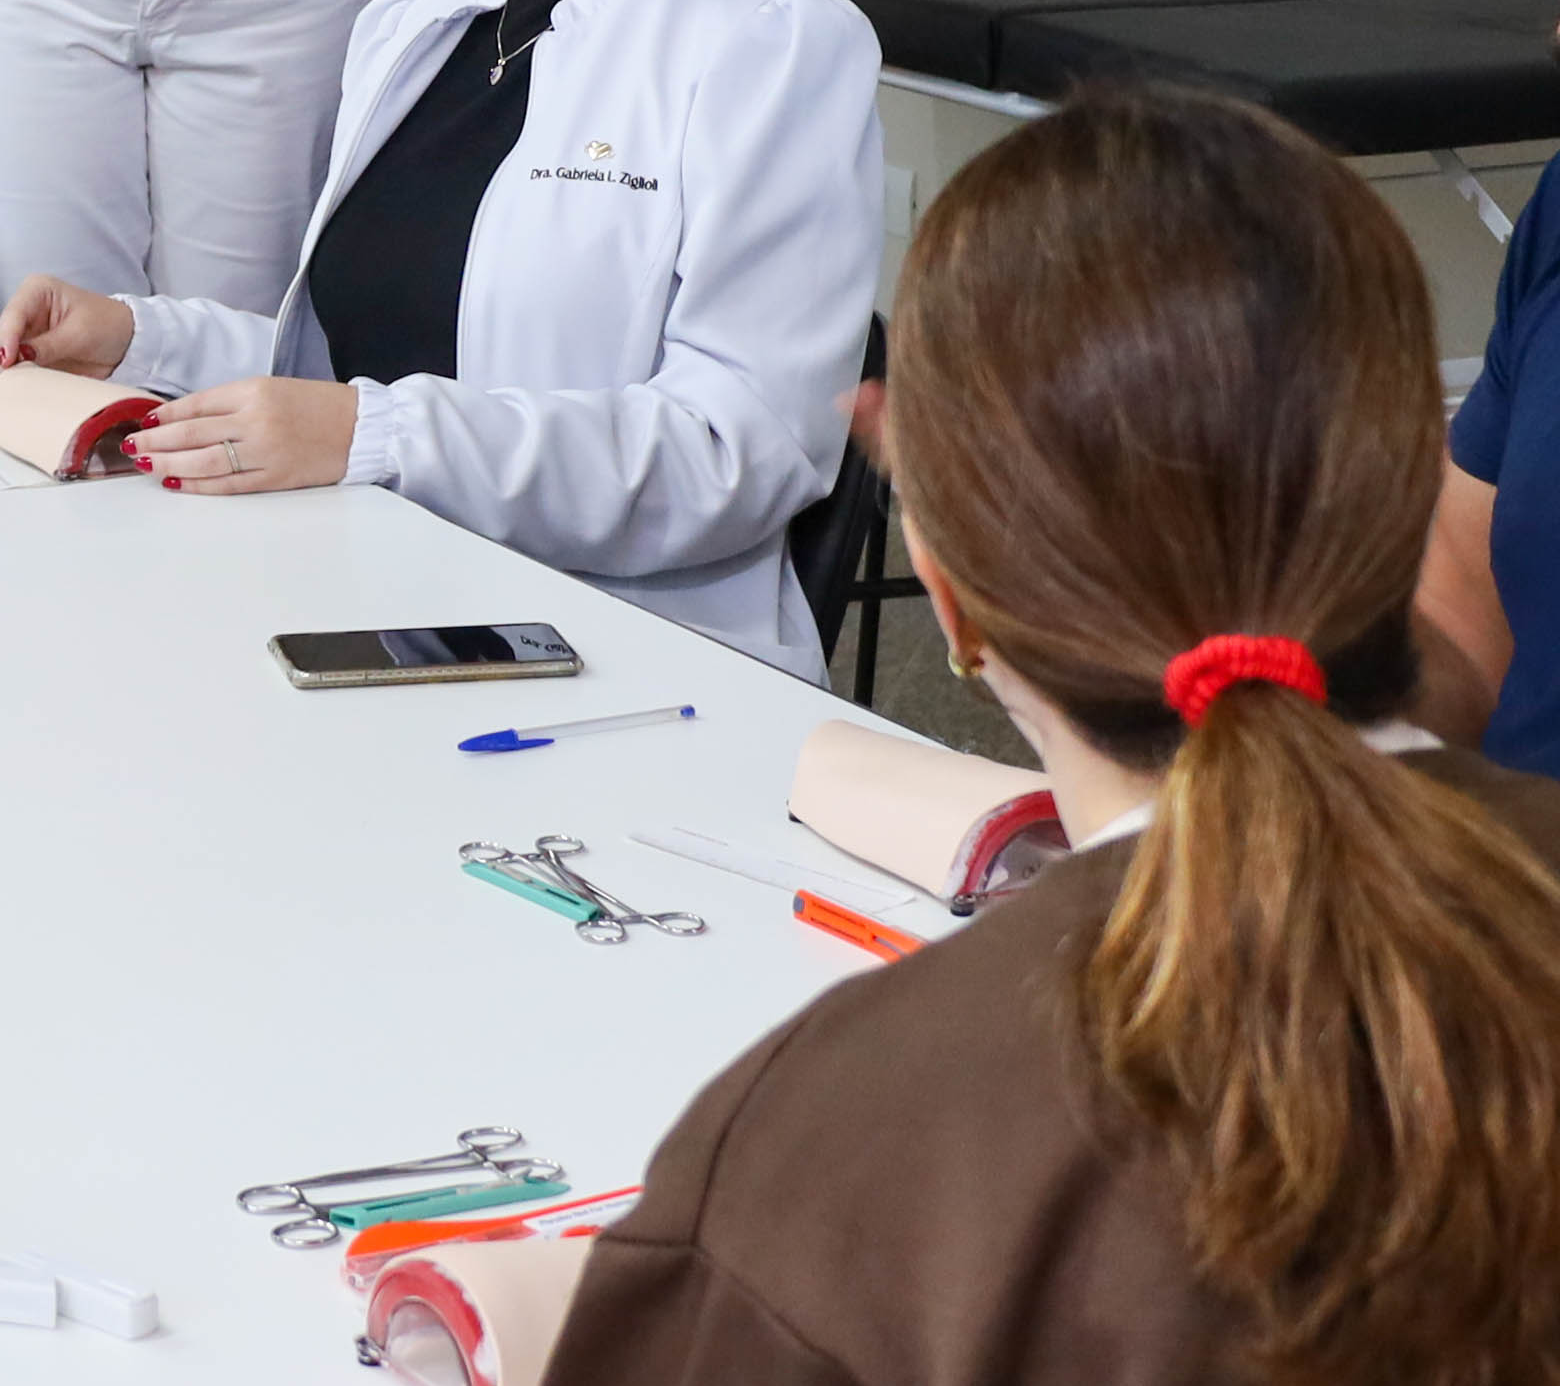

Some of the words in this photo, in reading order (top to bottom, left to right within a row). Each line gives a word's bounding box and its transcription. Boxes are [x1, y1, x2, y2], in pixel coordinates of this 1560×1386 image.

[530, 168, 552, 180] Dra.
[556, 167, 605, 182] Gabriela
[607, 170, 616, 183] L.
[619, 172, 658, 191] Ziglioli
